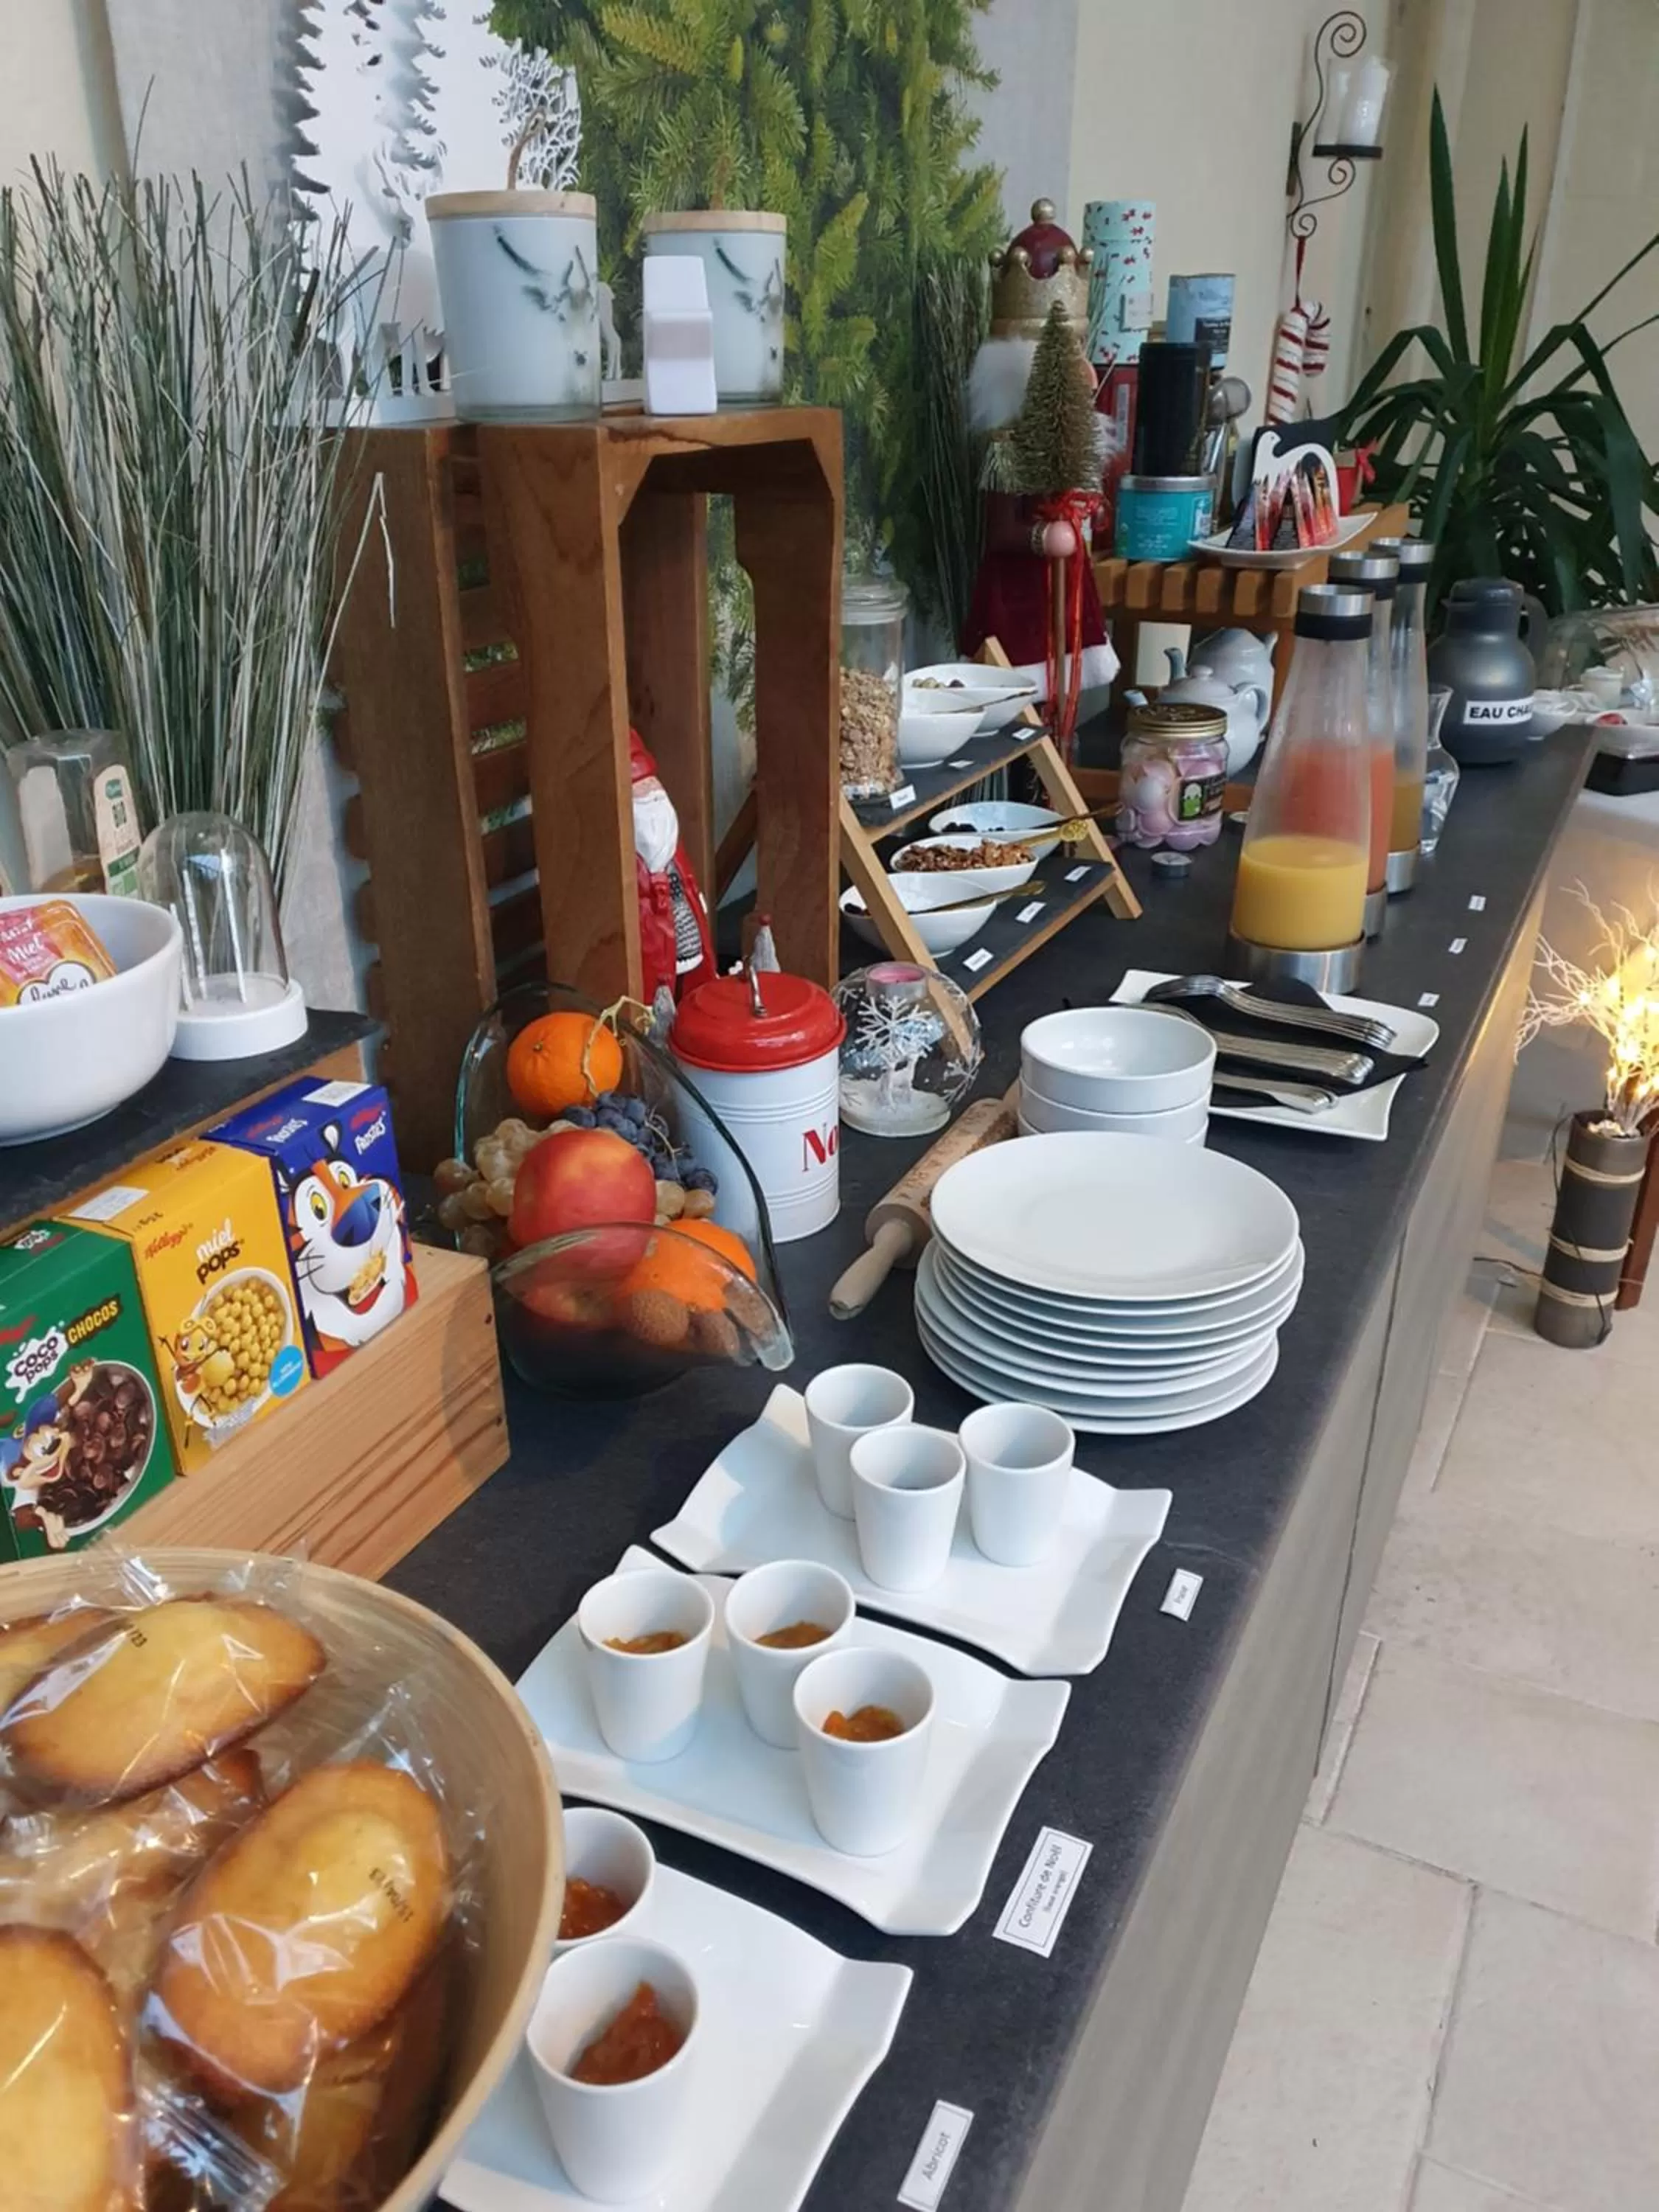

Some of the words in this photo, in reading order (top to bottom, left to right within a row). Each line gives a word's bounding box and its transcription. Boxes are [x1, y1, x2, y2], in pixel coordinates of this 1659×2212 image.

[1470, 706, 1503, 719] EAU
[196, 1218, 234, 1262] miel
[196, 1241, 240, 1284] pops
[67, 1300, 119, 1345] CHOCOS
[26, 1349, 59, 1384] pops
[1018, 1882, 1047, 1928] Confiture
[1040, 1869, 1052, 1882] de
[922, 2132, 950, 2181] Abricot
